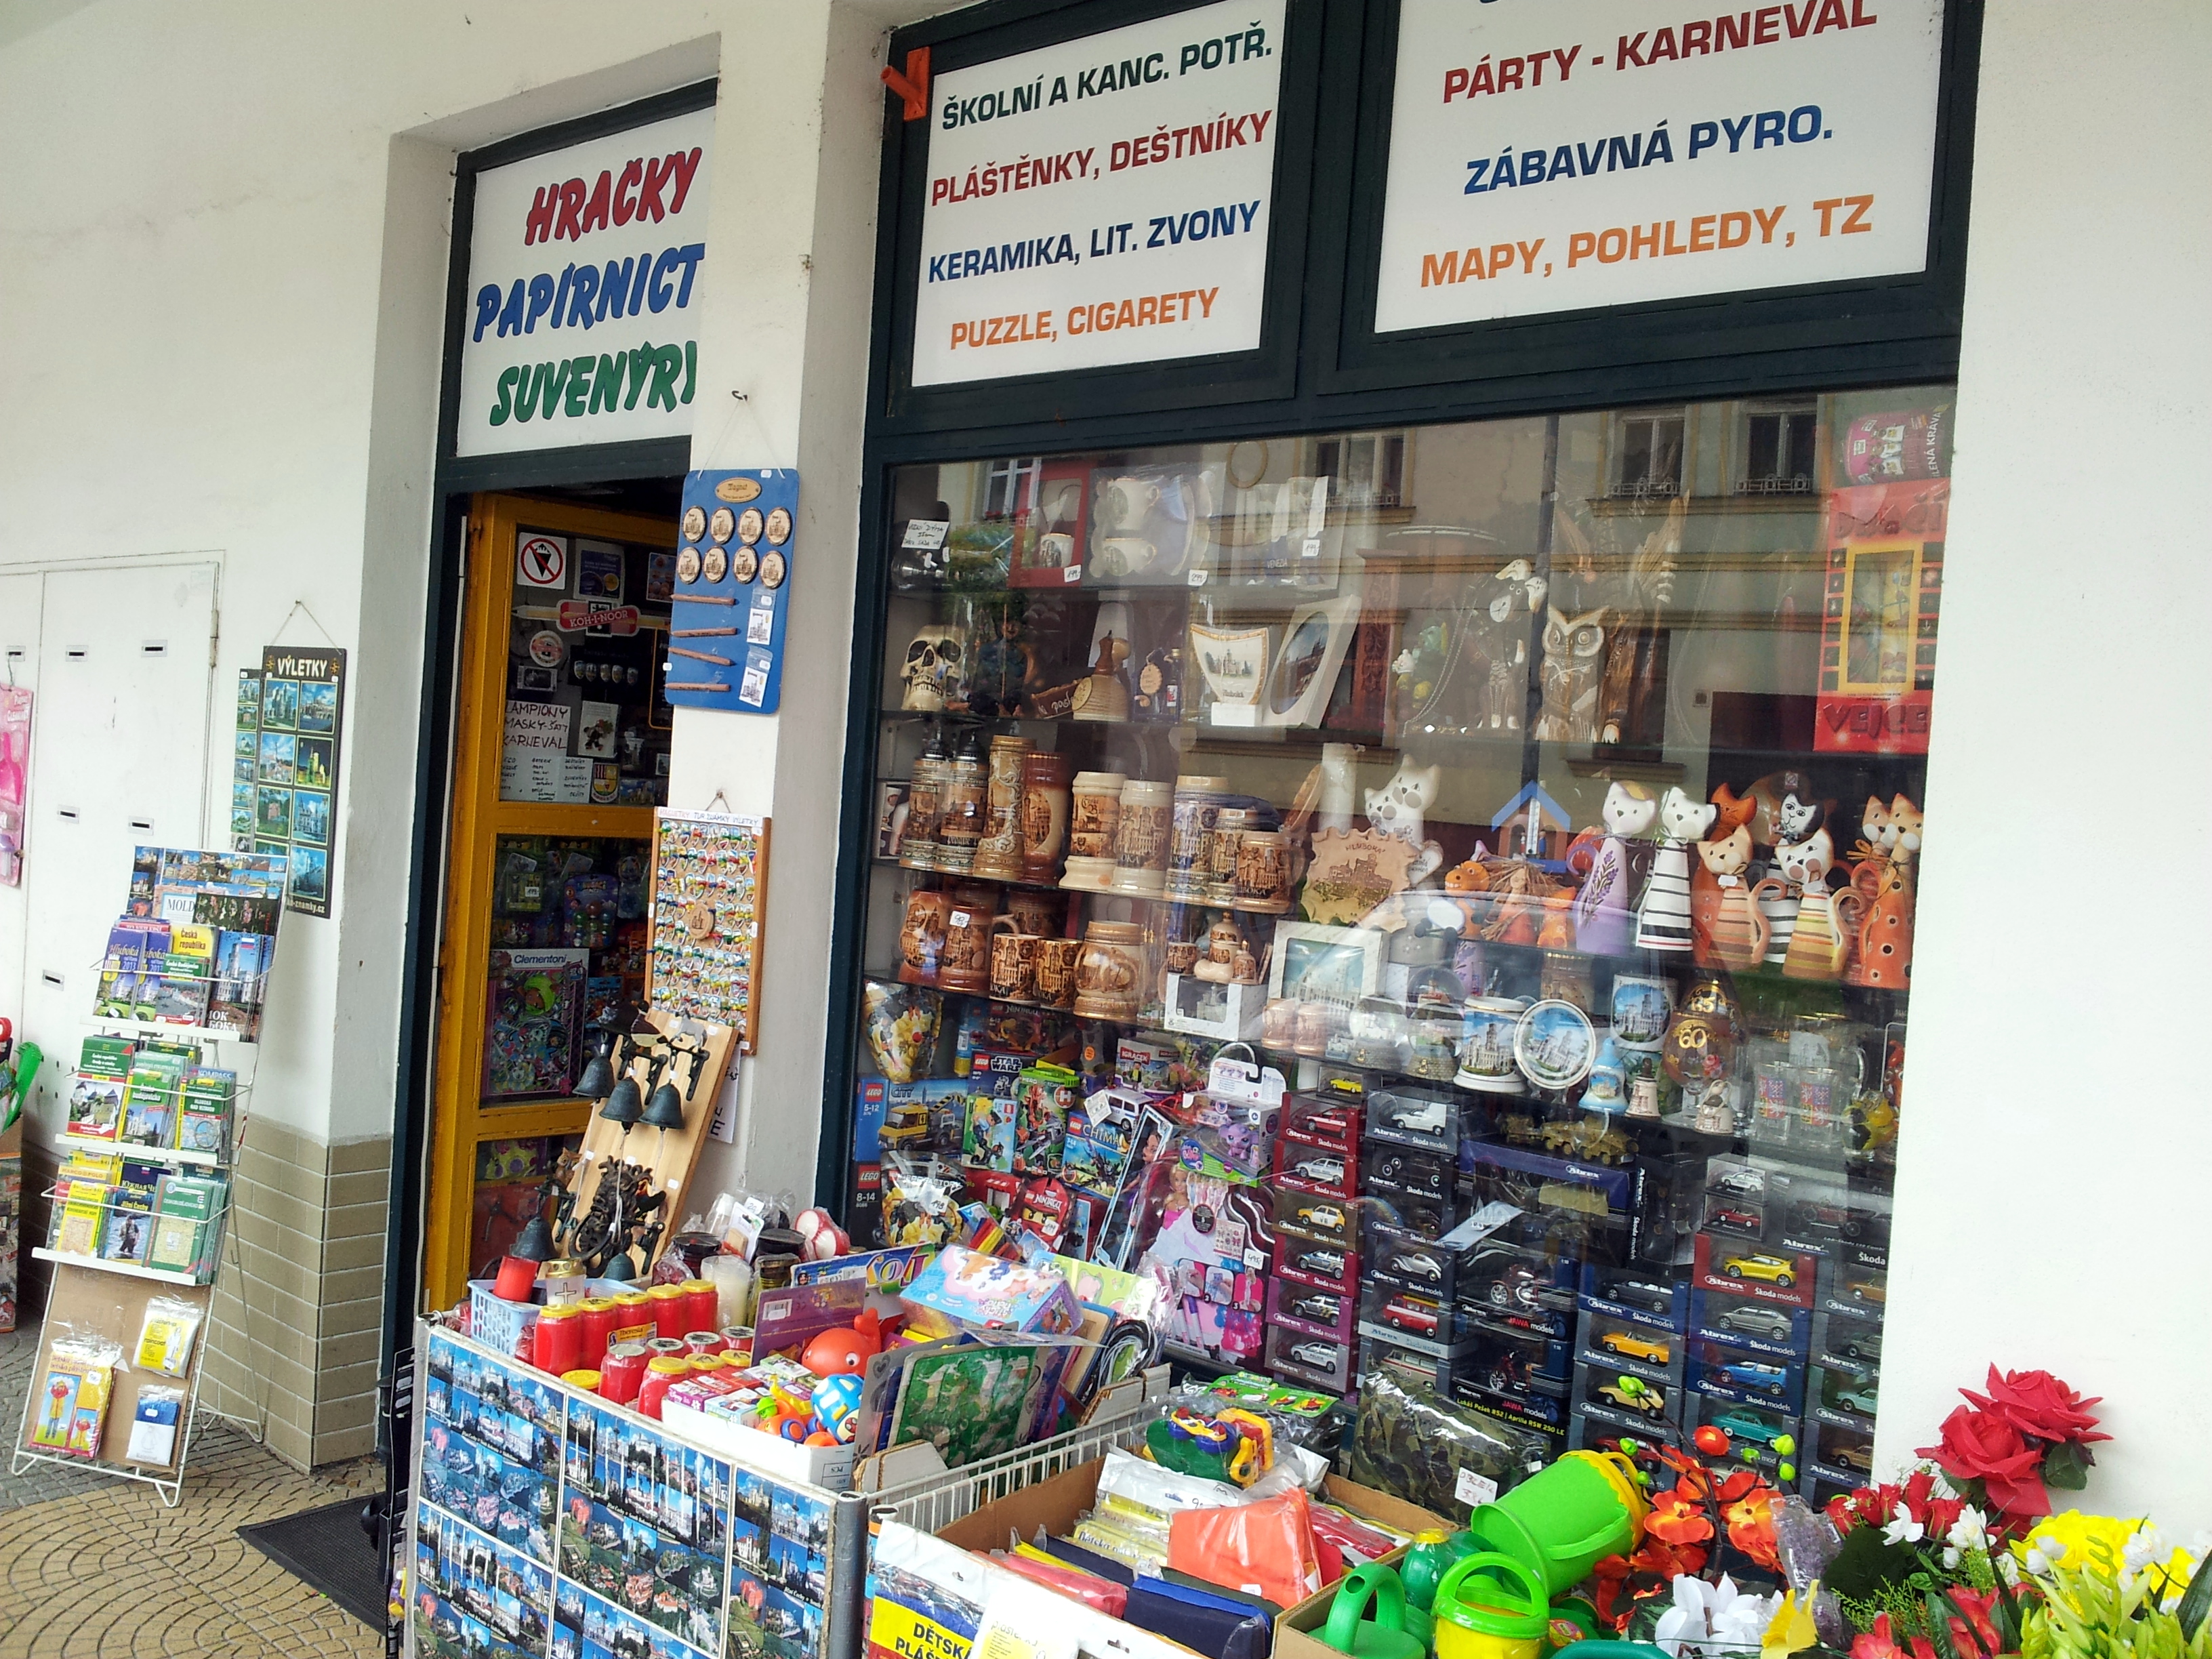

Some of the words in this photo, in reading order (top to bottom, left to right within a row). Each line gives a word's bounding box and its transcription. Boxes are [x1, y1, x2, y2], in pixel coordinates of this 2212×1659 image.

[1443, 45, 1582, 103] PÁRTY
[1616, 0, 1878, 70] KARNEVAL
[943, 75, 1044, 129] ŠKOLNÍ
[1048, 76, 1069, 106] A
[1076, 53, 1170, 99] KANC.
[1180, 20, 1272, 75] POTŘ.
[932, 147, 1100, 206] PLÁŠTĚNKY,
[1110, 110, 1272, 172] DEŠTNÍKY
[1463, 119, 1674, 194] ZÁBAVNÁ
[1687, 104, 1833, 159] PYRO.
[525, 147, 702, 245] HRAČKY
[928, 233, 1080, 283] KERAMIKA,
[1090, 224, 1138, 257] LIT.
[1147, 201, 1261, 248] ZVONY
[1420, 238, 1553, 288] MAPY,
[1567, 205, 1795, 269] POHLEDY,
[1813, 194, 1875, 237] TZ
[473, 243, 705, 342] PAPÍRNICT
[950, 311, 1058, 350] PUZZLE,
[1067, 287, 1219, 335] CIGARETY
[277, 654, 327, 678] VÝLETKY
[505, 701, 569, 720] LAMPIONY
[1822, 703, 1928, 741] VEJCE
[514, 954, 567, 966] Clementoni
[1678, 1028, 1707, 1049] 60
[991, 1056, 1022, 1065] STAR
[992, 1063, 1021, 1072] WARS
[197, 1069, 232, 1081] KOMPASS
[866, 1088, 882, 1097] LEGO
[890, 1086, 914, 1098] CITY
[864, 1104, 880, 1112] 5-12
[1070, 1122, 1082, 1130] LEGO
[1083, 1124, 1120, 1146] CHIMA
[1286, 1128, 1313, 1141] Abrex
[1318, 1138, 1332, 1148] Škoda
[1332, 1142, 1349, 1151] models
[1374, 1127, 1403, 1139] Abrex
[1412, 1136, 1429, 1146] Škoda
[1429, 1140, 1449, 1150] models
[859, 1171, 880, 1181] LEGO
[1565, 1164, 1602, 1179] Abrex
[856, 1192, 876, 1202] 8-14
[1279, 1176, 1306, 1186] Abrex
[1314, 1185, 1330, 1195] Škoda
[1330, 1189, 1347, 1200] models
[1368, 1175, 1397, 1187] Abrex
[1406, 1185, 1423, 1195] Škoda
[1424, 1189, 1443, 1200] models
[1636, 1167, 1647, 1205] Abrex
[1033, 1193, 1062, 1212] NINJAGO
[1279, 1220, 1309, 1233] Abrex
[1313, 1232, 1329, 1242] Škoda
[1329, 1237, 1347, 1247] models
[1372, 1221, 1404, 1235] Abrex
[1410, 1233, 1427, 1244] Škoda
[1427, 1238, 1446, 1249] models
[1633, 1215, 1641, 1233] Škoda
[1629, 1235, 1637, 1261] models
[1782, 1238, 1824, 1252] Abrex
[1858, 1252, 1886, 1265] Škoda
[1279, 1265, 1309, 1279] Abrex
[1313, 1276, 1329, 1286] Škoda
[1329, 1282, 1347, 1292] models
[1371, 1269, 1403, 1284] Abrex
[1408, 1282, 1425, 1292] Škoda
[1425, 1286, 1443, 1297] models
[1704, 1275, 1747, 1290] Abrex
[1755, 1287, 1777, 1298] Škoda
[1777, 1292, 1802, 1303] models
[1462, 1303, 1488, 1317] Abrex
[1588, 1297, 1626, 1314] Abrex
[1632, 1312, 1652, 1324] Škoda
[1652, 1317, 1675, 1329] models
[1826, 1298, 1870, 1316] Abrex
[1273, 1313, 1303, 1327] Abrex
[1308, 1325, 1324, 1336] Škoda
[1324, 1330, 1342, 1341] models
[1508, 1316, 1529, 1328] JAWA
[1530, 1323, 1555, 1335] models
[144, 1337, 167, 1346] raincoat
[1406, 1338, 1422, 1347] Škoda
[1422, 1343, 1441, 1355] models
[1700, 1328, 1738, 1342] Abrex
[1749, 1340, 1771, 1351] Škoda
[1771, 1345, 1797, 1357] models
[1271, 1358, 1300, 1372] Abrex
[1306, 1371, 1322, 1382] Škoda
[1322, 1376, 1338, 1387] models
[1583, 1349, 1618, 1363] Abrex
[1628, 1364, 1649, 1375] Škoda
[1649, 1370, 1671, 1381] models
[1821, 1355, 1860, 1369] Abrex
[1456, 1385, 1482, 1399] Abrex
[1697, 1380, 1738, 1396] Abrex
[1745, 1394, 1767, 1406] Škoda
[1767, 1400, 1791, 1412] models
[1456, 1398, 1473, 1409] Lukáš
[1473, 1403, 1491, 1414] Pešek
[1508, 1413, 1528, 1425] Aprilia
[1528, 1420, 1542, 1429] RSW
[1542, 1425, 1555, 1433] 250
[1502, 1400, 1523, 1412] JAWA
[1523, 1408, 1548, 1420] models
[1580, 1401, 1619, 1418] Abrex
[1625, 1417, 1645, 1429] Škoda
[1645, 1423, 1668, 1436] models
[1816, 1408, 1858, 1425] Abrex
[1809, 1465, 1849, 1480] Abrex
